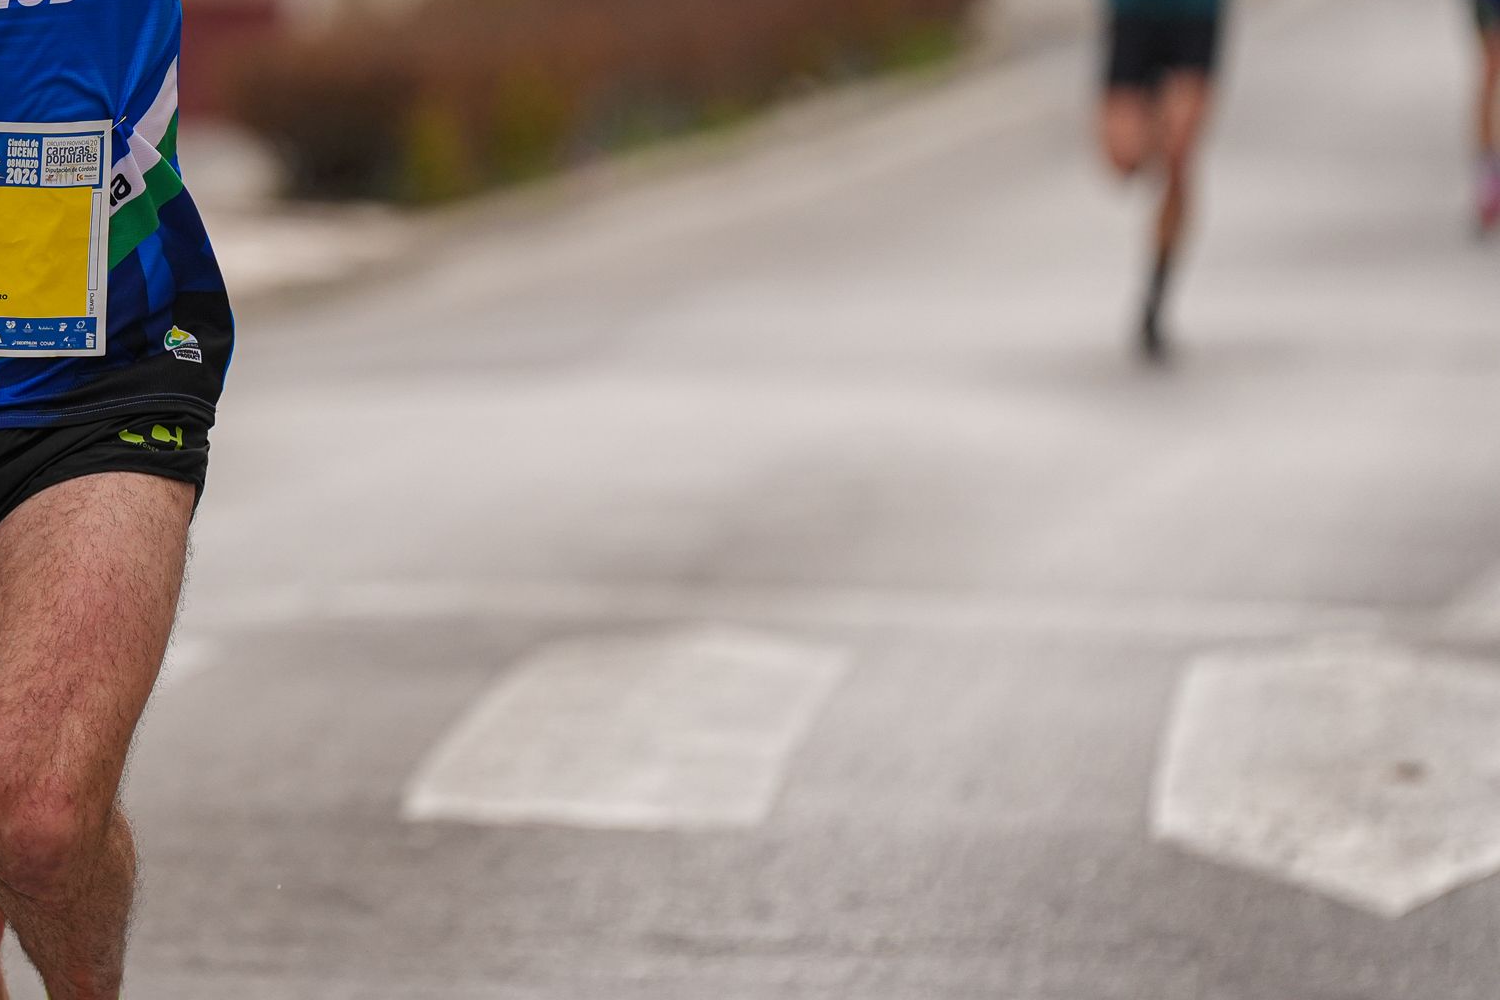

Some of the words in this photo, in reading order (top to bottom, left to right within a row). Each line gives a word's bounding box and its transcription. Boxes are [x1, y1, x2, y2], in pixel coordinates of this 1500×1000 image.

[8, 138, 30, 147] Ciudad
[31, 139, 39, 147] de
[7, 147, 38, 158] LUCENA
[46, 145, 90, 156] carreras
[46, 151, 98, 166] populares
[5, 167, 38, 185] 2026
